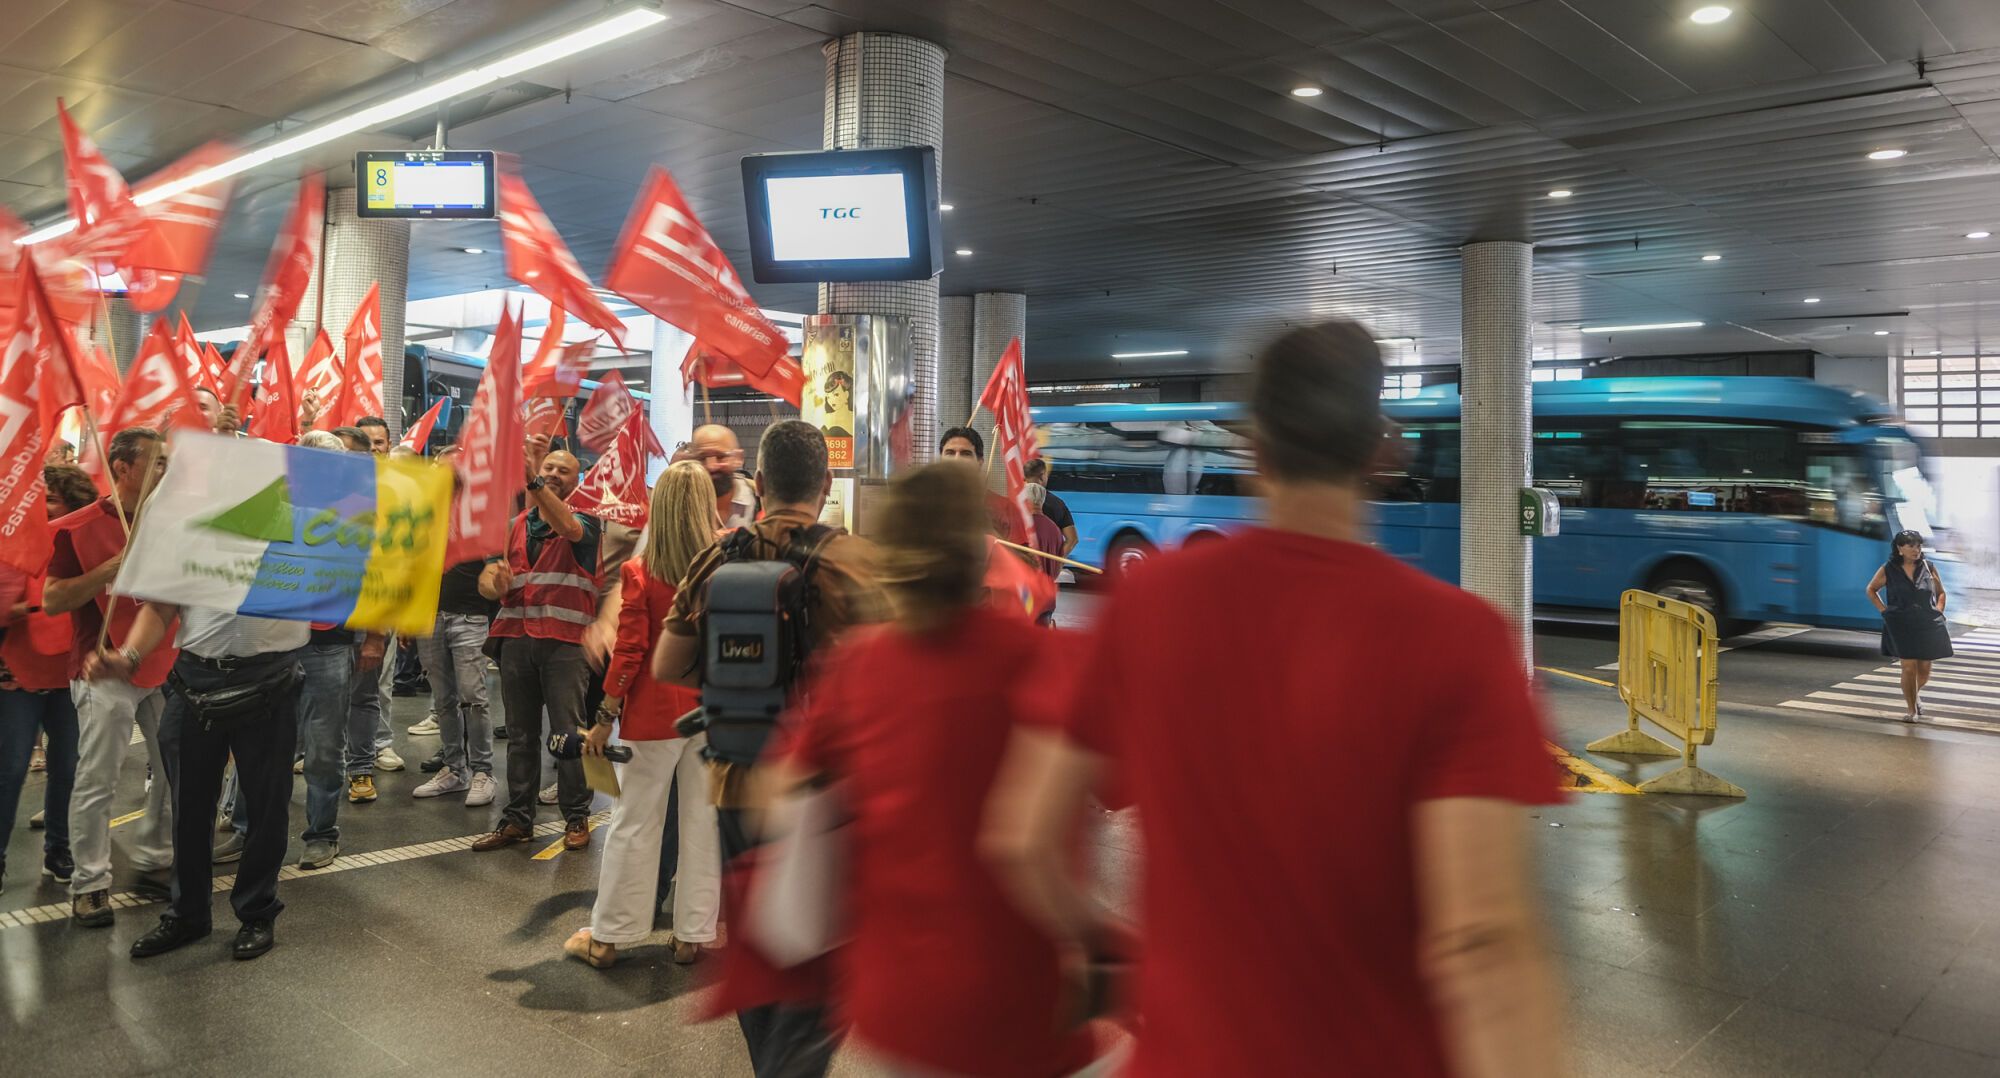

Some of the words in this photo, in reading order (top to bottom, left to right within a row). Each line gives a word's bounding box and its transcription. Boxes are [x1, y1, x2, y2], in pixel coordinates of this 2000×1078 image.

[376, 168, 387, 187] 8
[818, 207, 862, 220] TGC
[723, 312, 774, 346] canarias
[721, 639, 762, 658] LiveU
